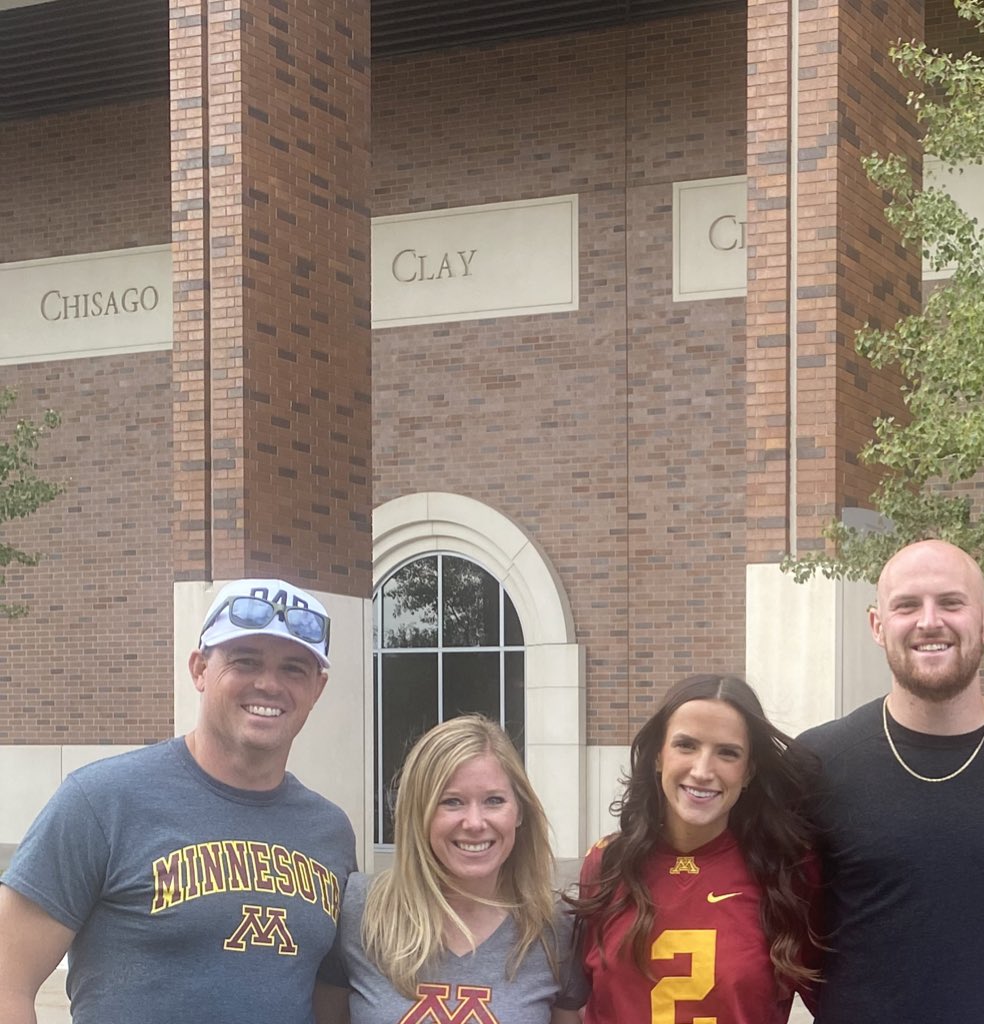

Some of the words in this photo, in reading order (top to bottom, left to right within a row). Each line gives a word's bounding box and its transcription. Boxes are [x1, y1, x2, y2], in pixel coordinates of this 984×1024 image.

[391, 249, 477, 283] CLAY
[40, 285, 159, 321] CHISAGO
[669, 856, 700, 875] M
[150, 840, 341, 929] MINNESOTA
[223, 904, 298, 956] M
